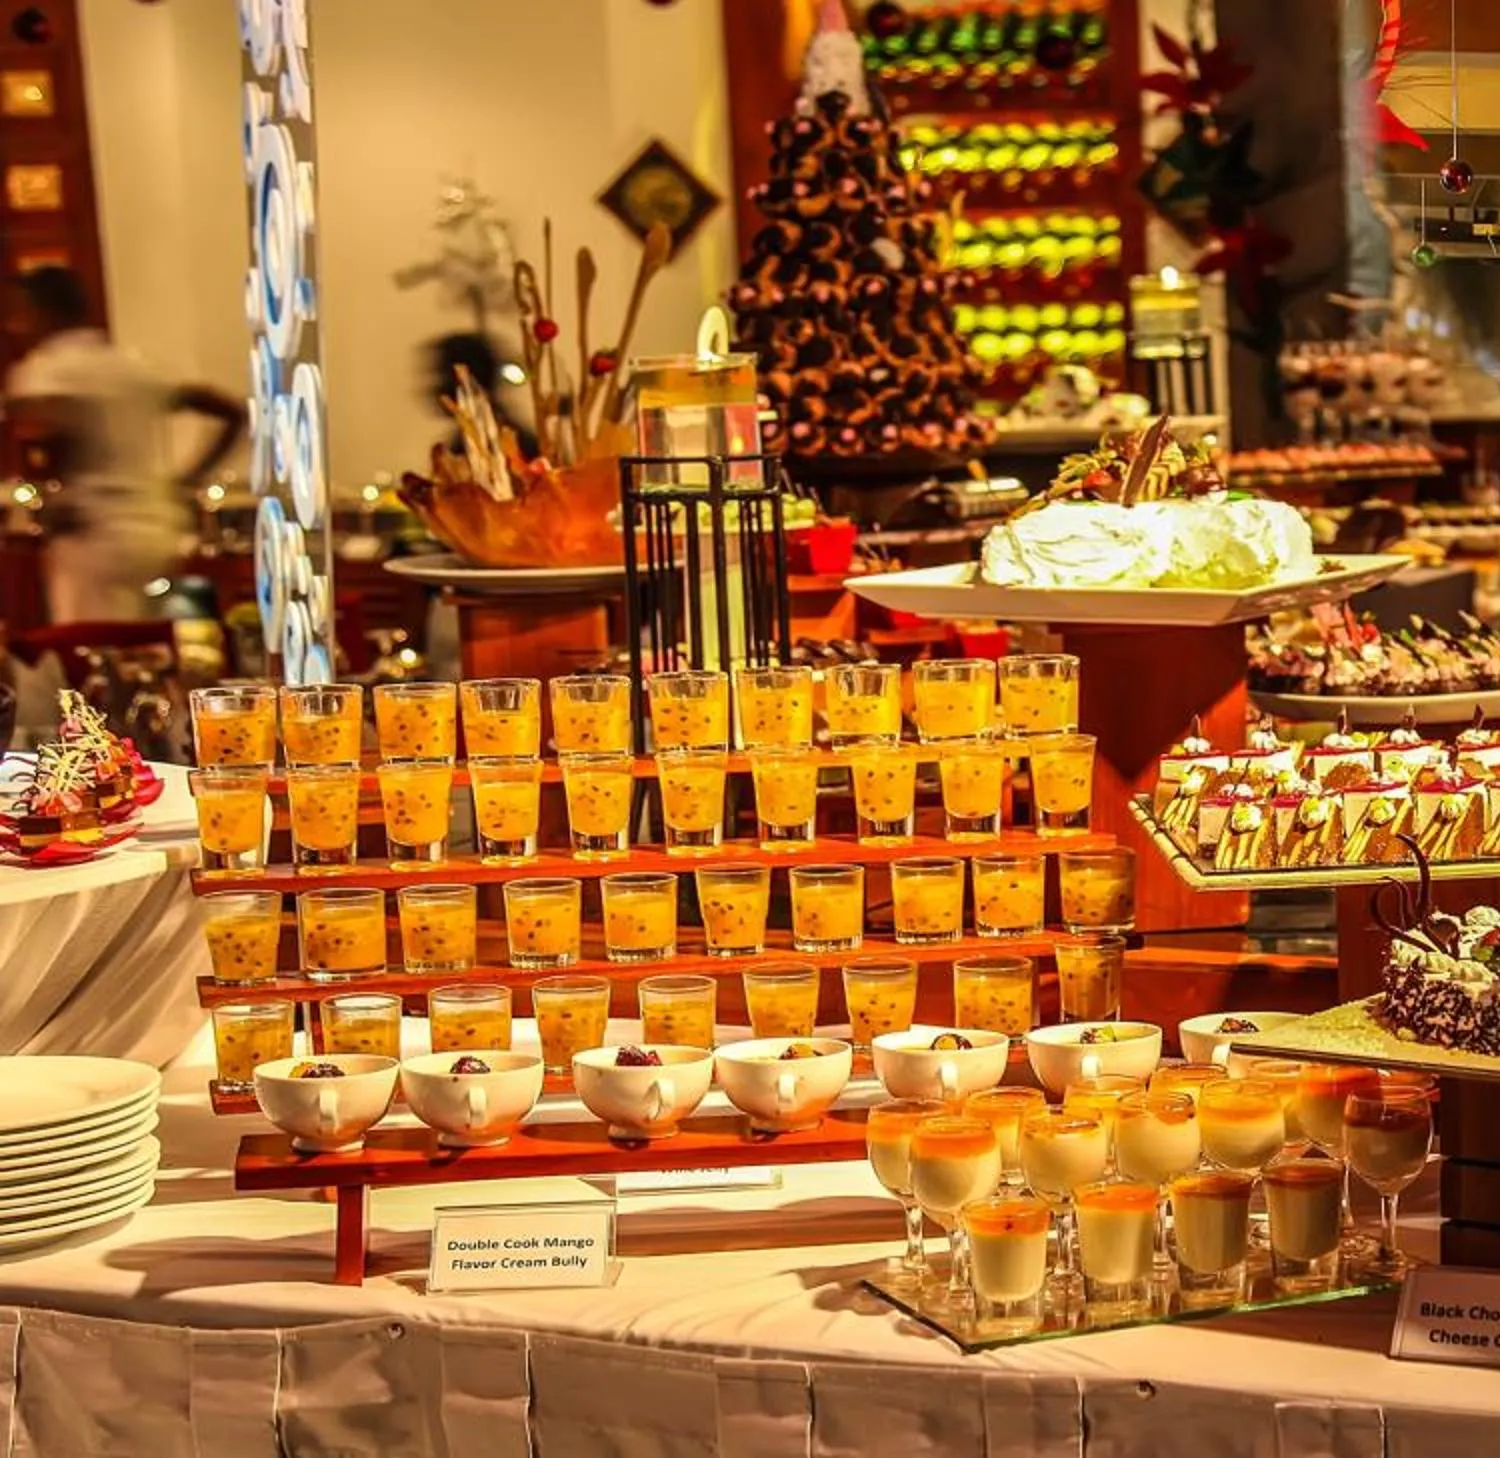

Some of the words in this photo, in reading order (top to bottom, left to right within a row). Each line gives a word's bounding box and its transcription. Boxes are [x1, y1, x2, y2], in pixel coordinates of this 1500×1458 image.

[447, 1239, 499, 1251] Double
[503, 1237, 539, 1249] Cook
[543, 1237, 595, 1249] Mango
[451, 1259, 496, 1270] Flavor
[500, 1257, 548, 1269] Cream
[551, 1255, 588, 1268] Bully
[1420, 1301, 1465, 1319] Black
[1429, 1329, 1490, 1347] Cheese
